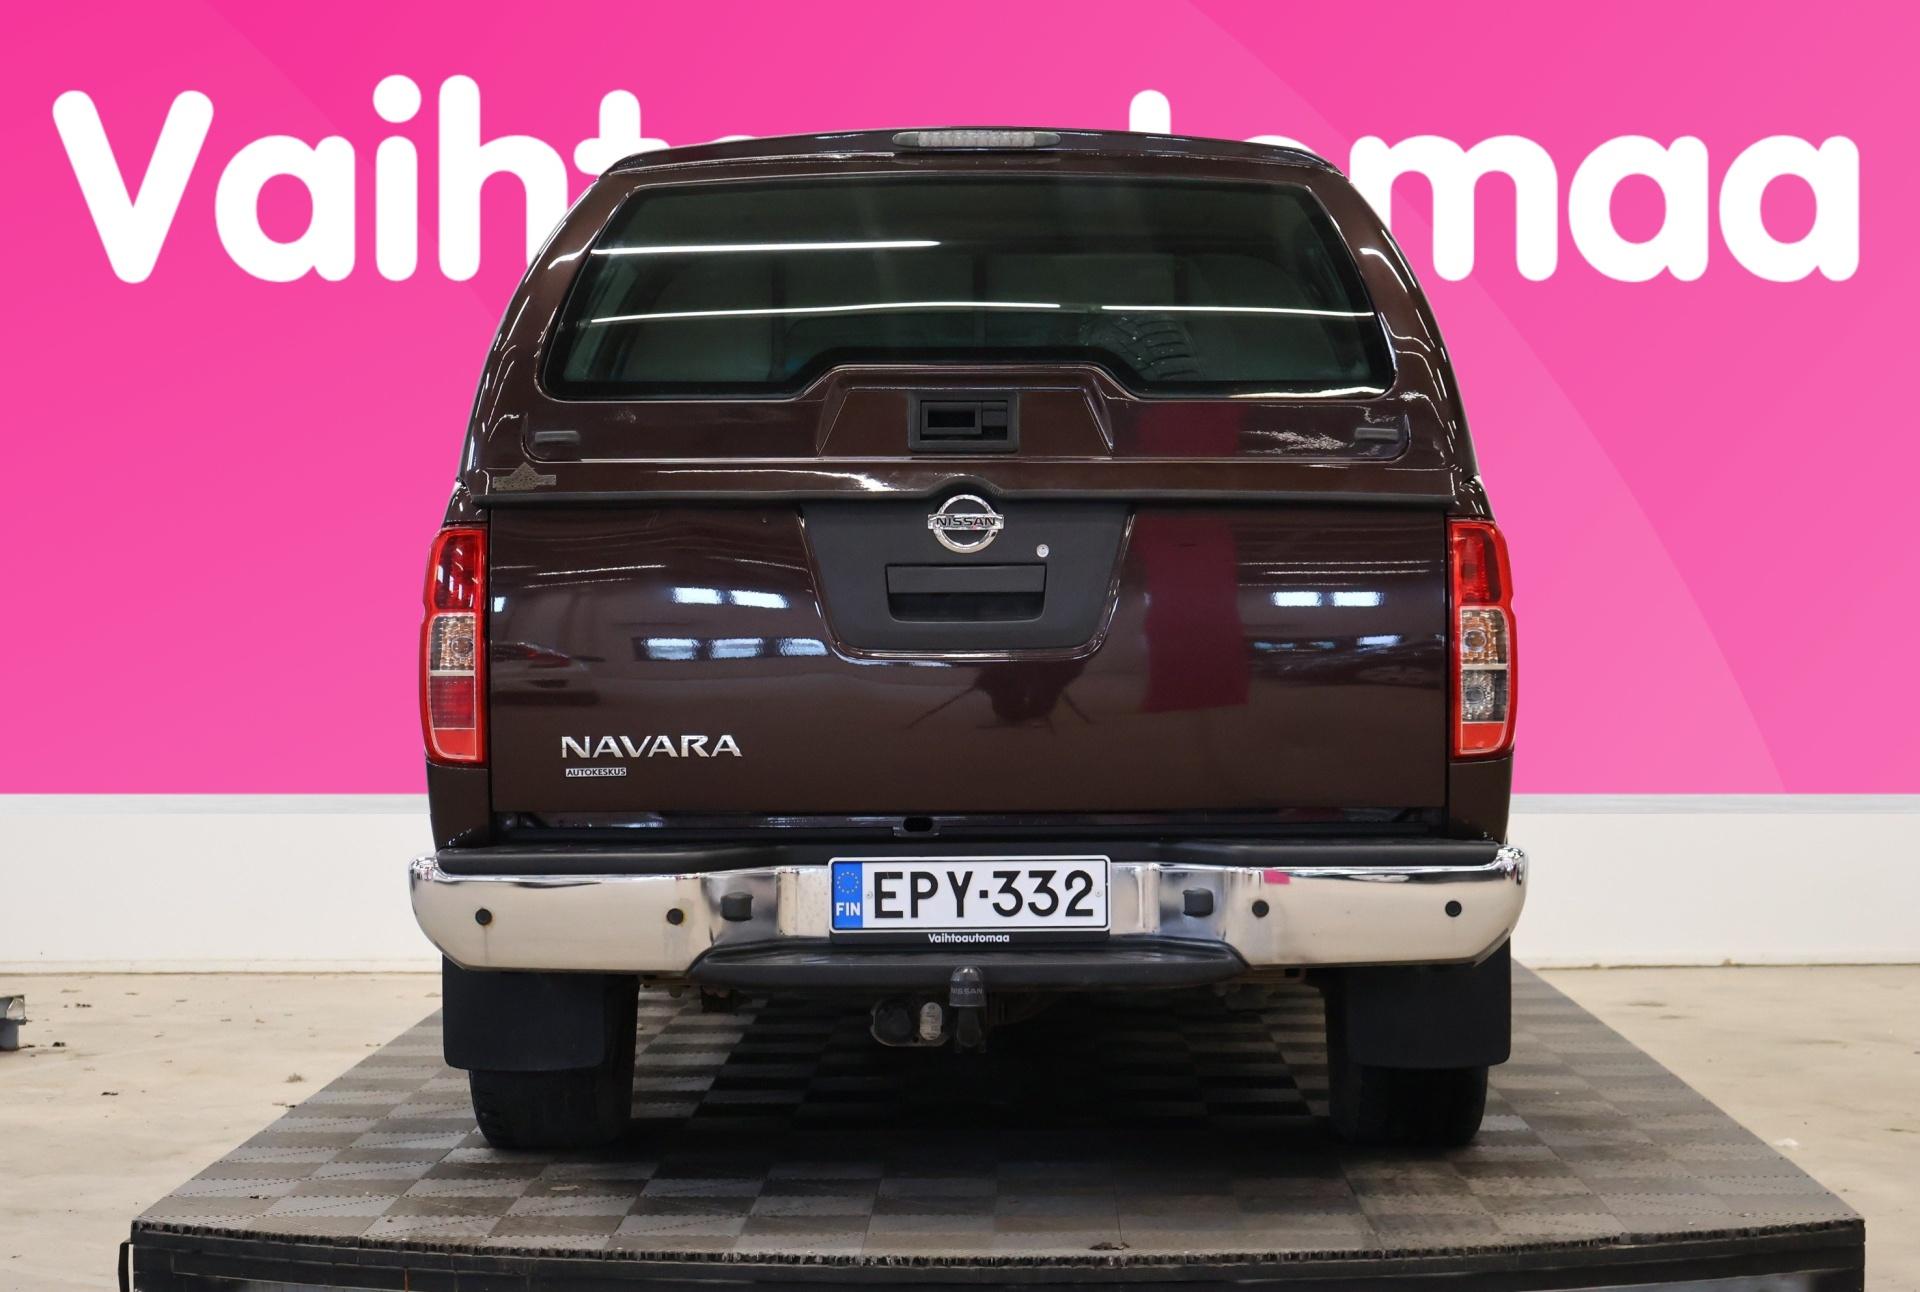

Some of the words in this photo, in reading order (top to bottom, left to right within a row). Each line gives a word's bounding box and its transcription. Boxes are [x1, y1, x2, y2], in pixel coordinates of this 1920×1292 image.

[52, 75, 1859, 283] Vaihmaa
[936, 516, 996, 526] NISSAN
[561, 735, 744, 758] NAVARA
[566, 768, 626, 777] AUTOKESKUS
[835, 902, 861, 916] FIN
[874, 869, 1094, 918] EPY-332
[927, 932, 1010, 944] Vaihtoautomaa
